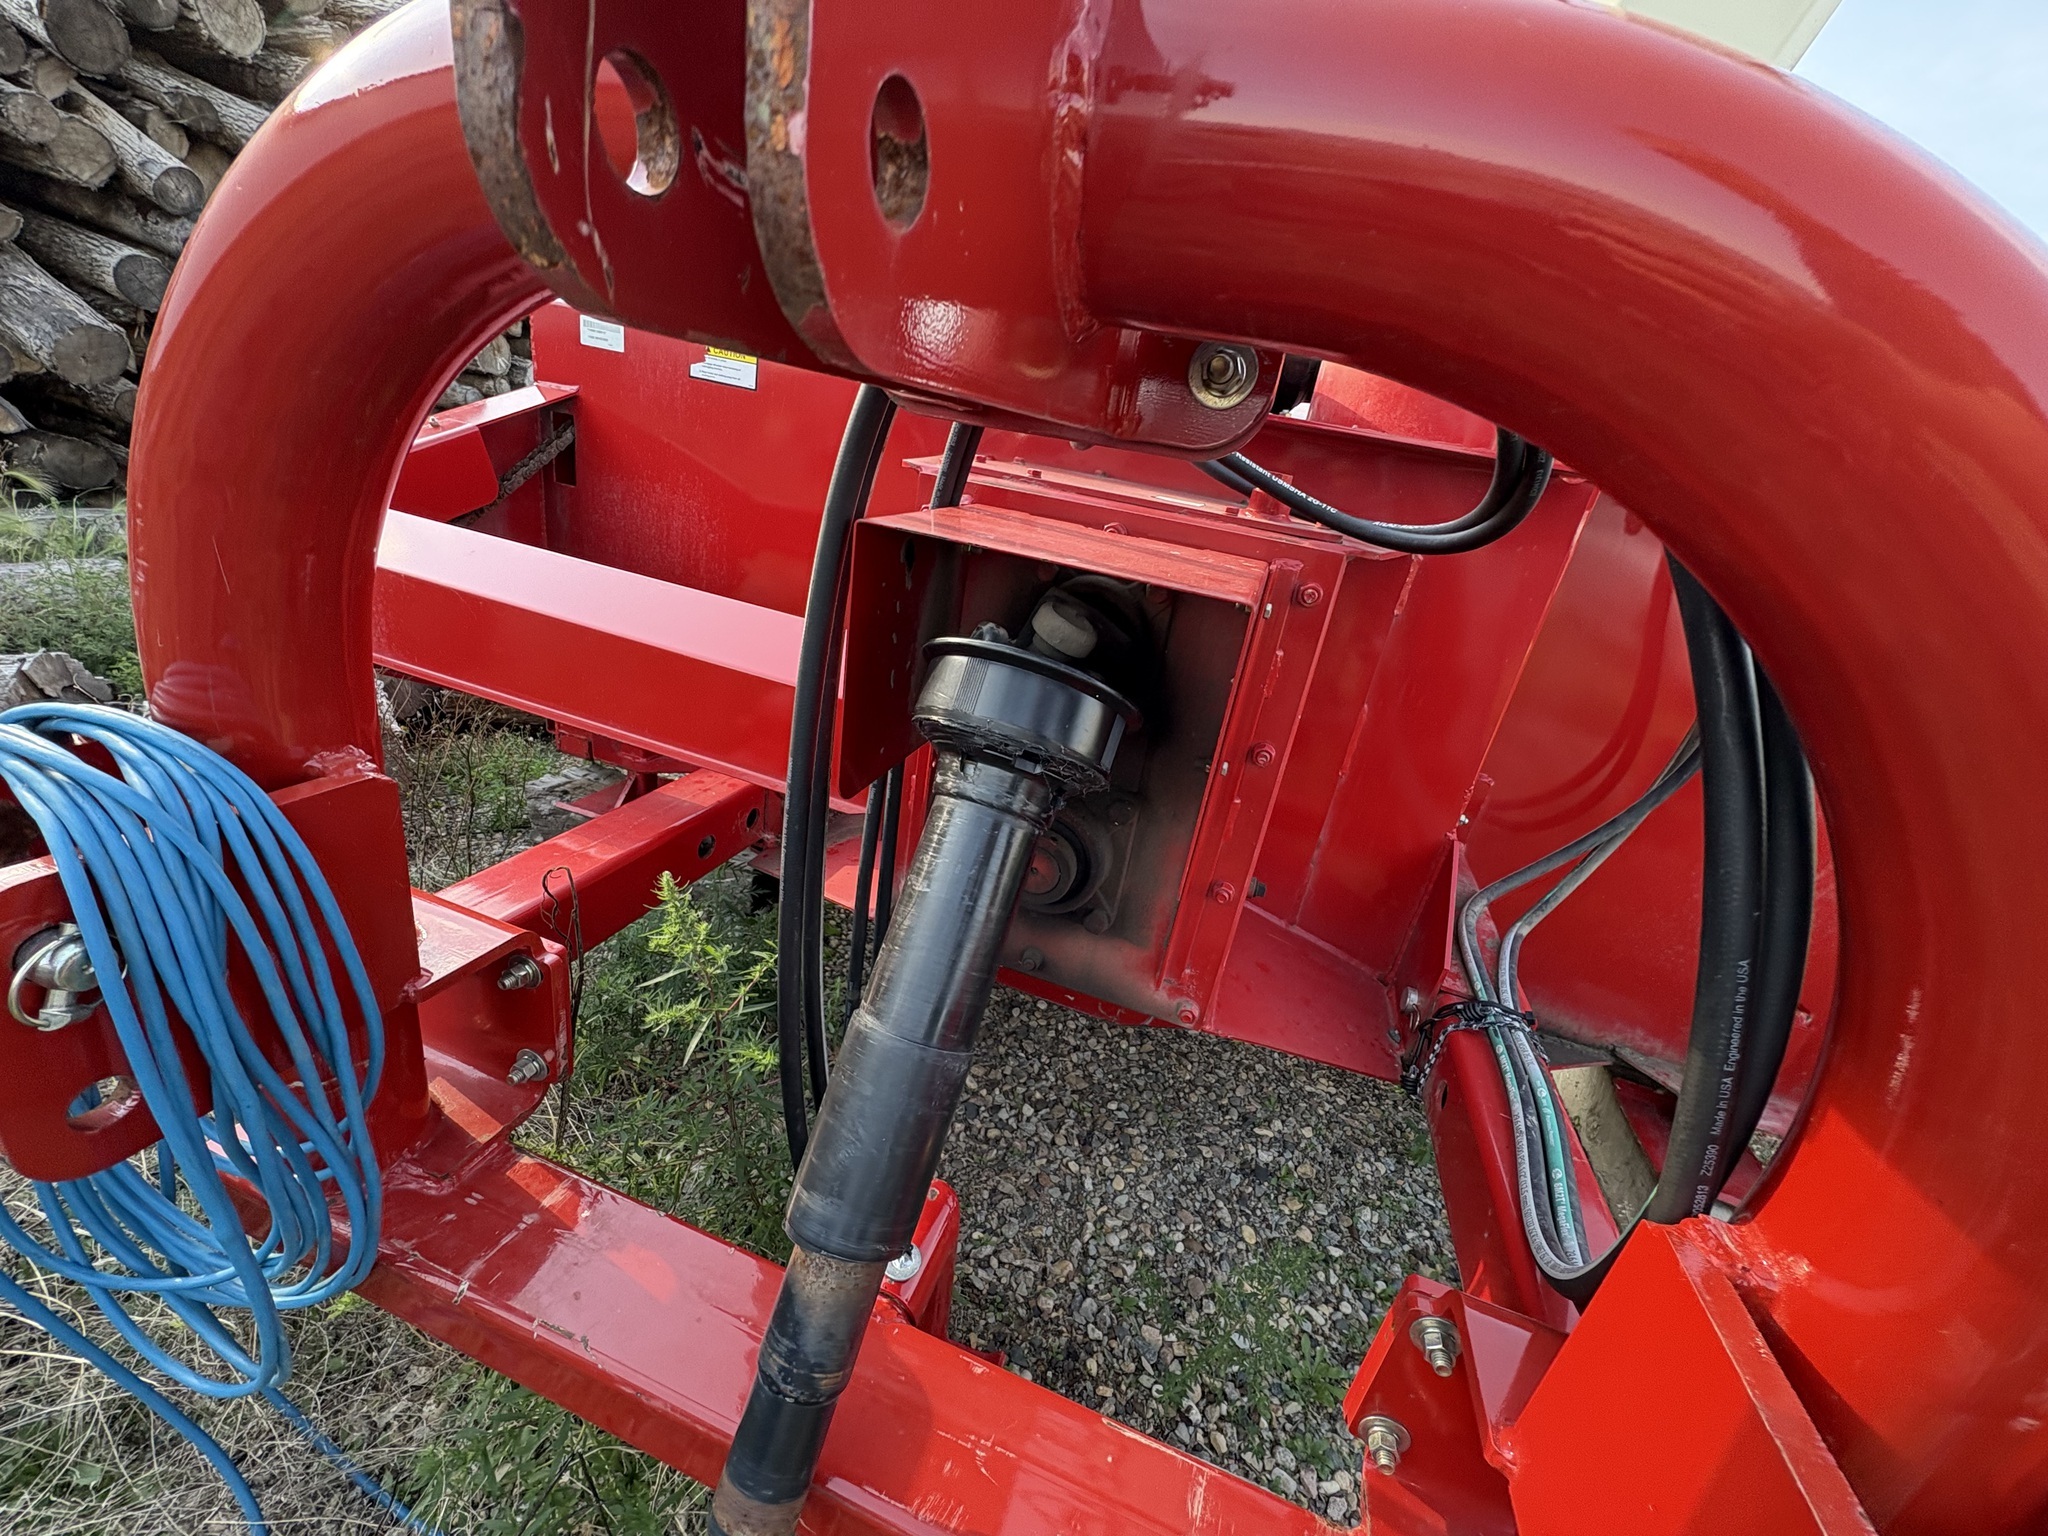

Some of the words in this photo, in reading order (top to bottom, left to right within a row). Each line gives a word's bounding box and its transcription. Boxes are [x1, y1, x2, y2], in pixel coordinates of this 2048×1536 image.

[1736, 958, 1752, 983] USA
[1735, 986, 1748, 1002] the
[1732, 1005, 1745, 1014] in
[1723, 1016, 1744, 1072] Engineered
[1718, 1077, 1734, 1098] USA
[1715, 1100, 1728, 1109] in
[1709, 1111, 1726, 1135] Made
[1700, 1144, 1719, 1176] Z25390
[1692, 1185, 1709, 1216] 052813
